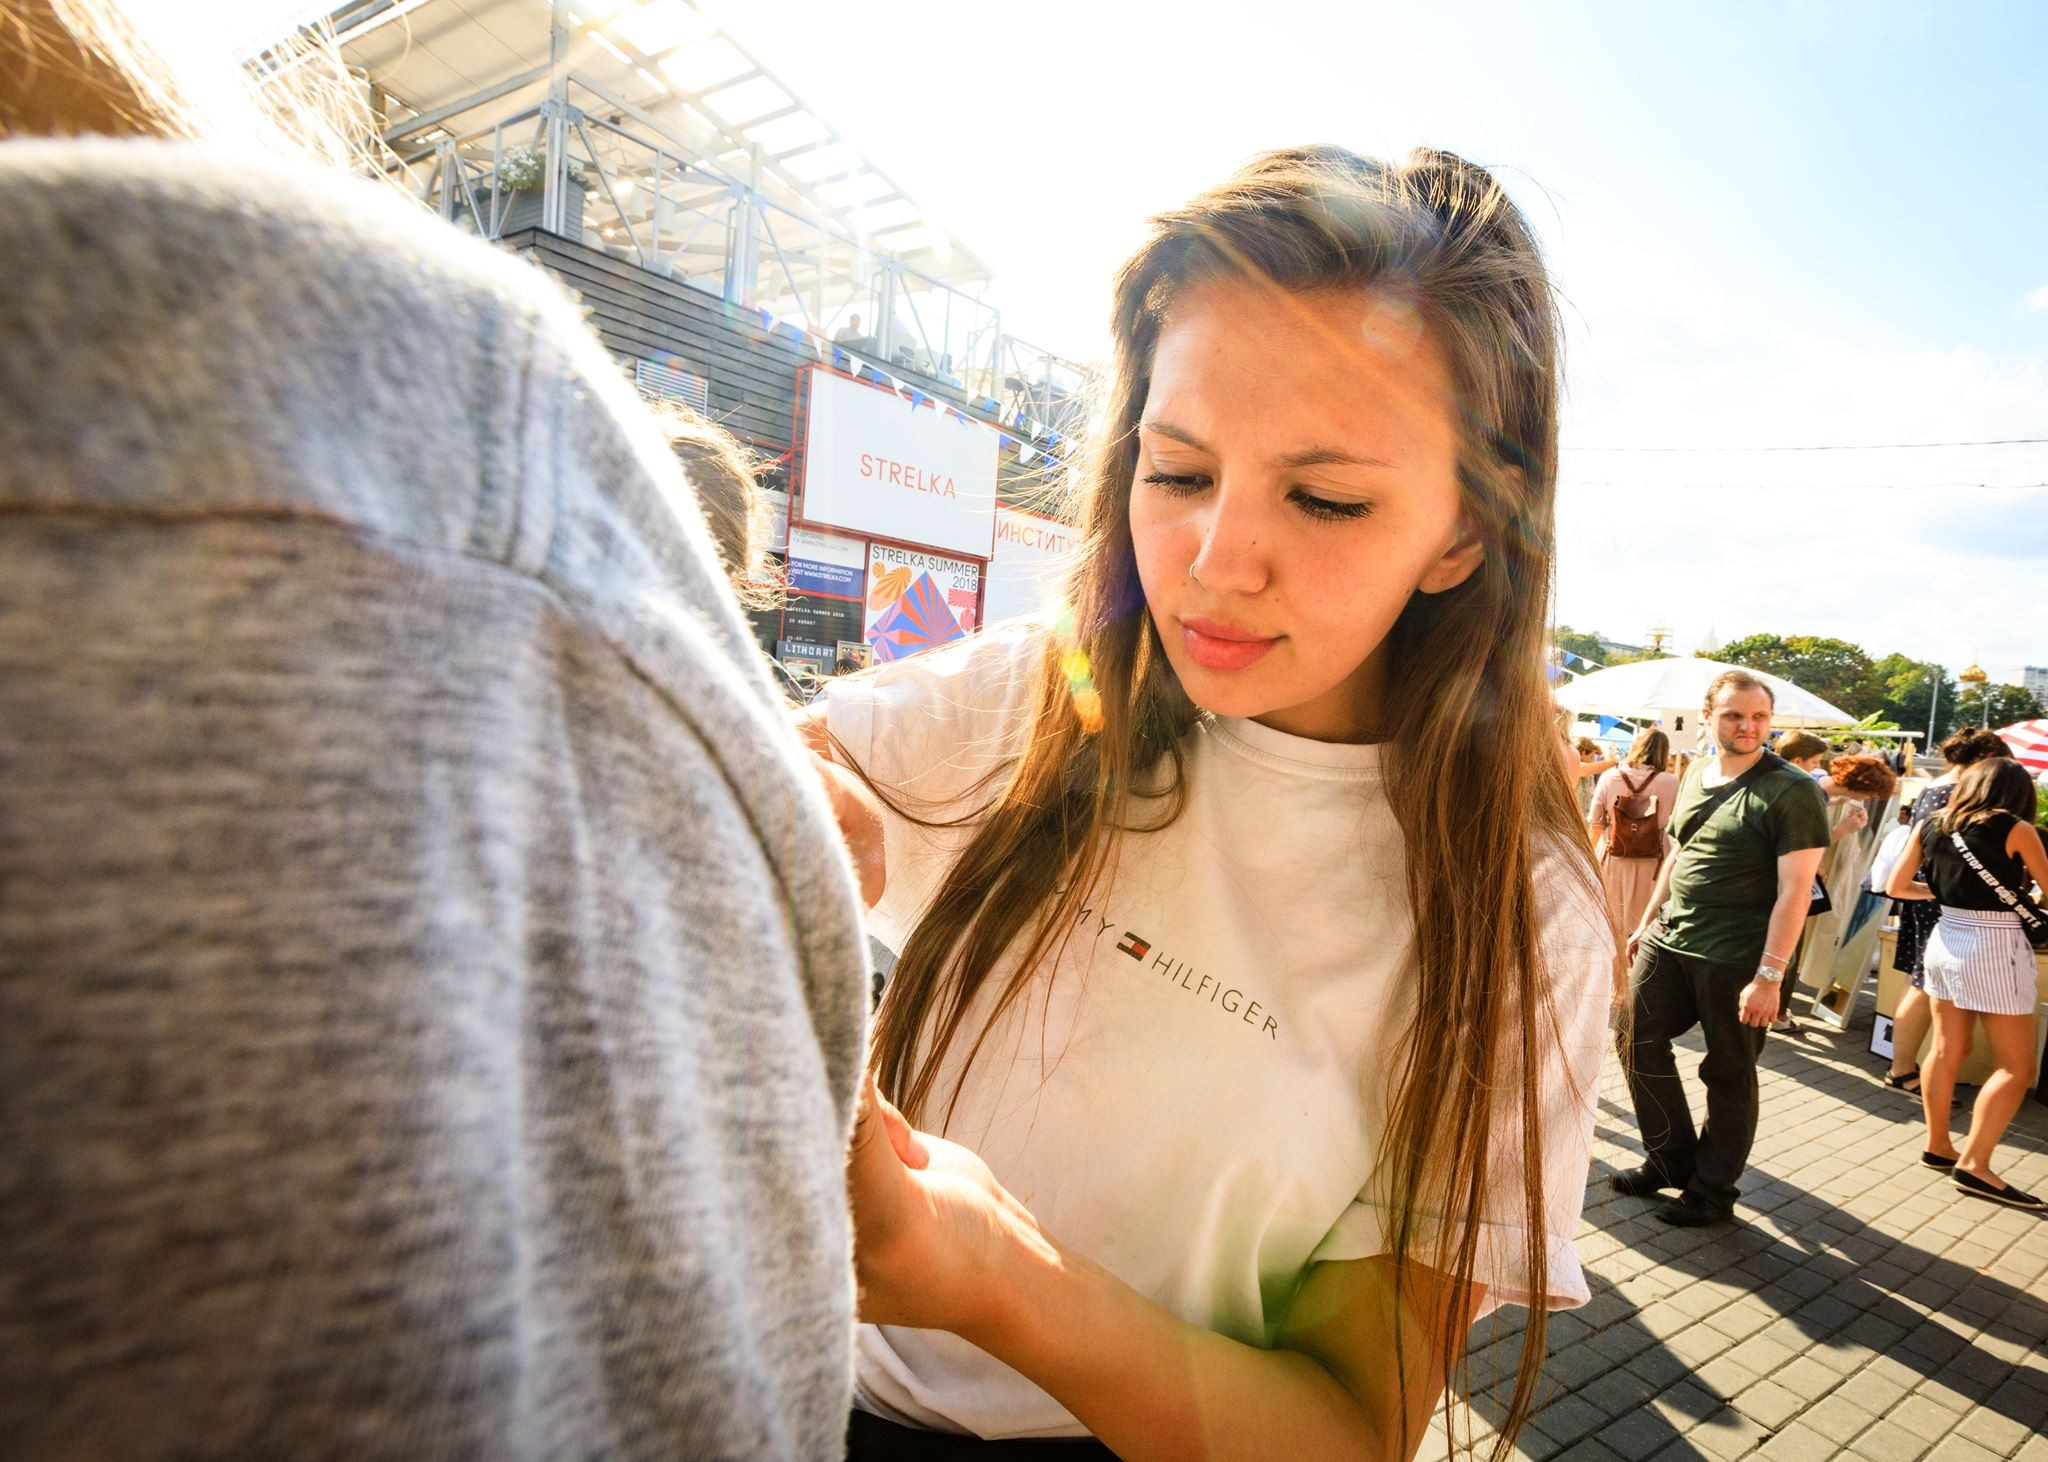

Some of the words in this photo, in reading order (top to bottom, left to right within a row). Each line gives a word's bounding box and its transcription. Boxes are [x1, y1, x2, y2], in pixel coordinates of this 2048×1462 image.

[860, 453, 956, 500] STRELKA
[791, 560, 802, 568] FOR
[803, 562, 818, 571] MORE
[819, 565, 853, 576] INFORMATION
[872, 545, 925, 568] STRELKA
[928, 557, 978, 578] SUMMER
[791, 567, 804, 575] VISIT
[804, 570, 852, 583] WWW.STRELKA.COM
[953, 576, 977, 591] 2018
[785, 644, 834, 657] LITHOART
[1962, 851, 1984, 870] STOP
[1978, 869, 2000, 887] KEEP
[1994, 885, 2018, 906] GOING
[2014, 903, 2038, 923] DON'T
[1151, 951, 1278, 1040] HILFIGER
